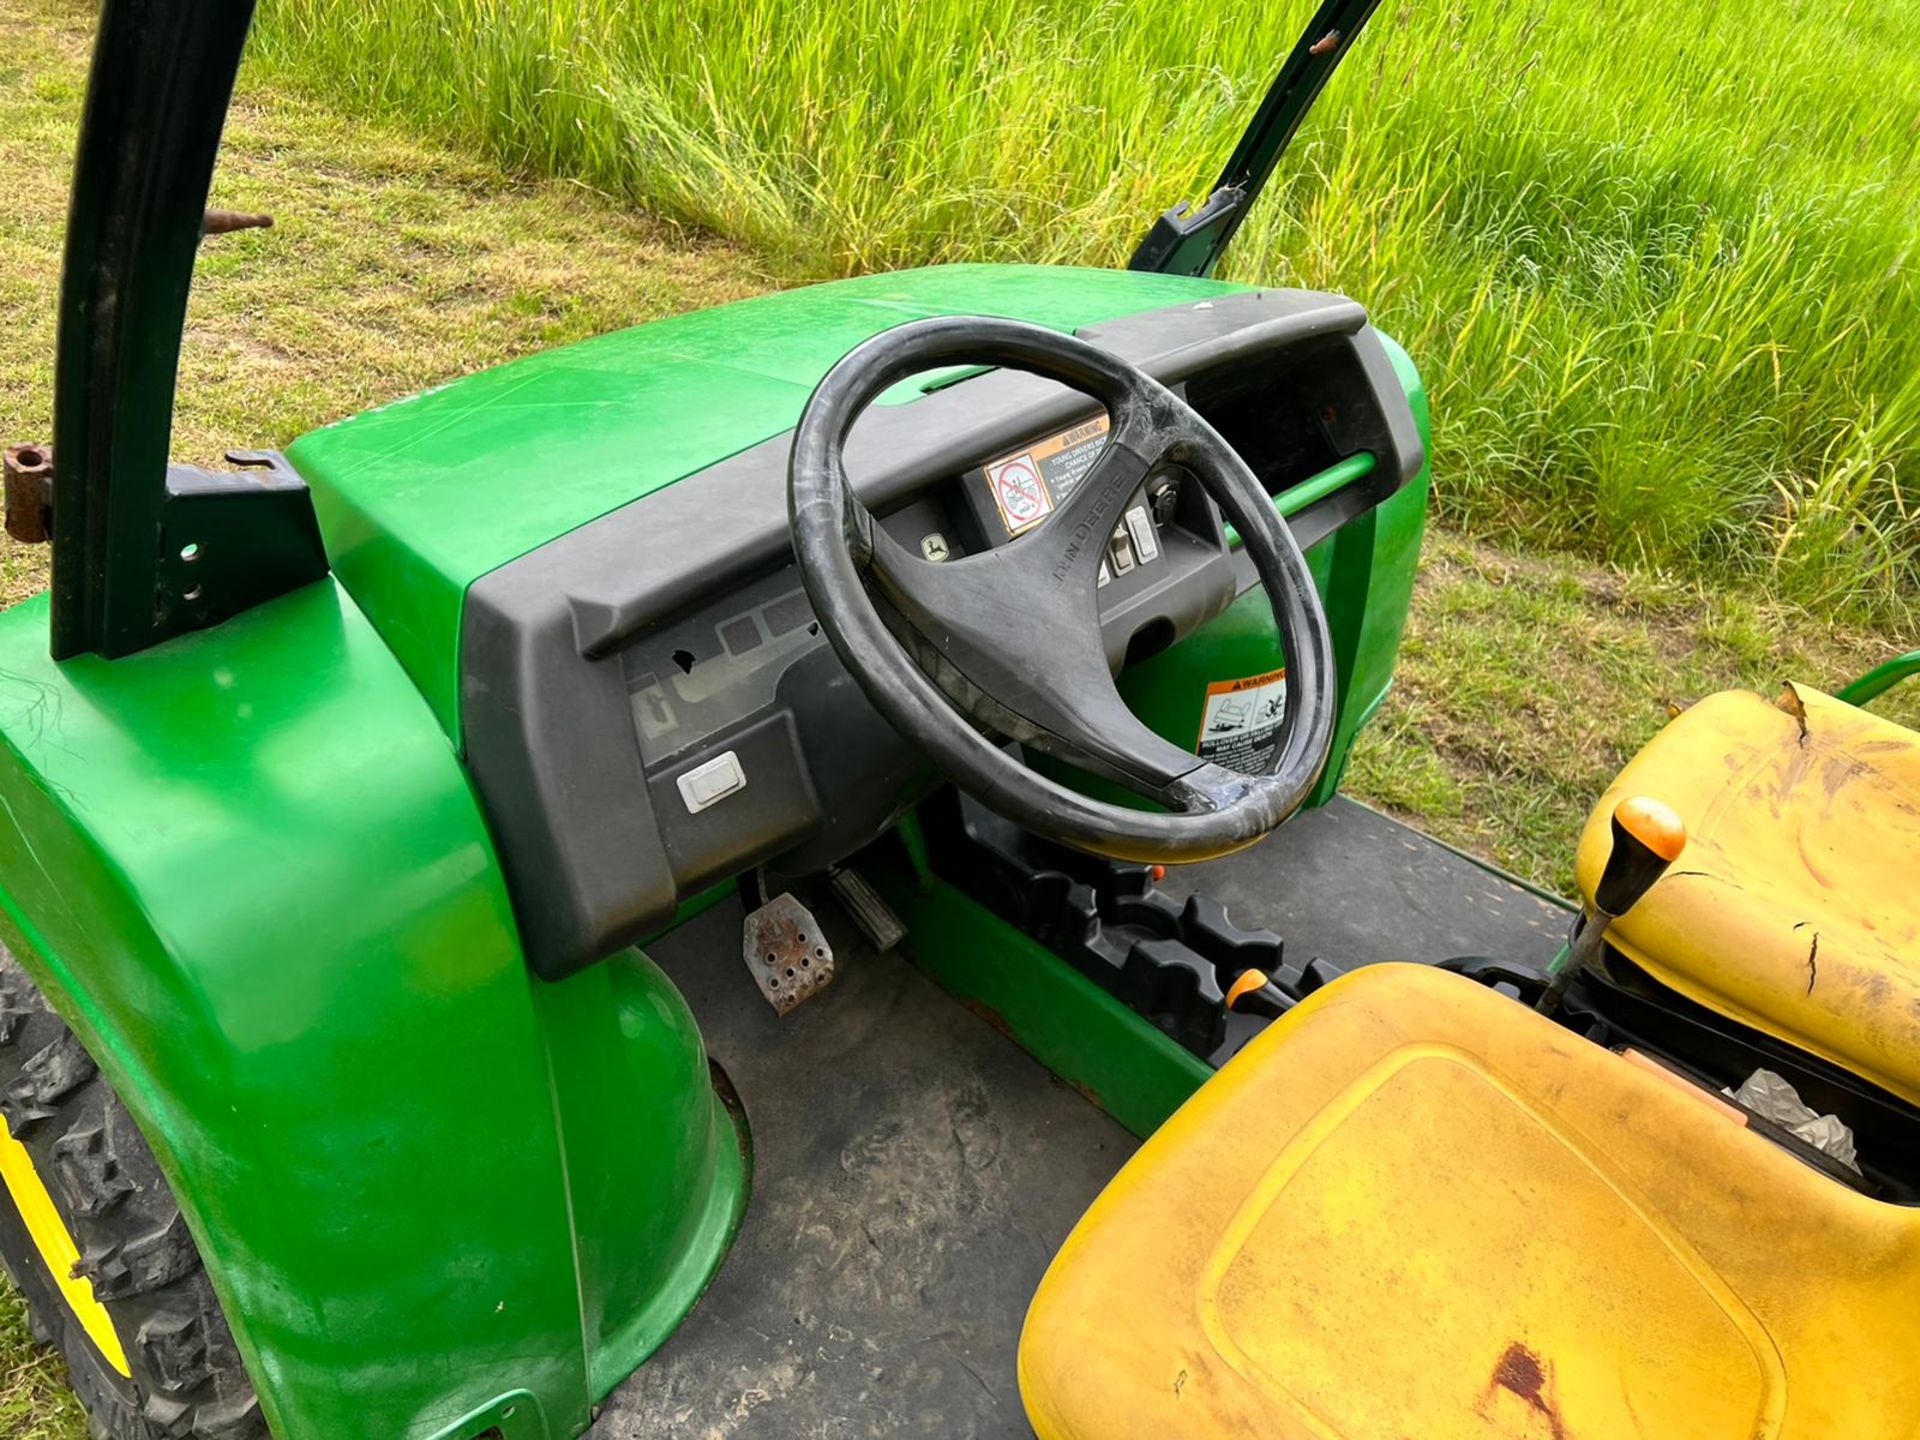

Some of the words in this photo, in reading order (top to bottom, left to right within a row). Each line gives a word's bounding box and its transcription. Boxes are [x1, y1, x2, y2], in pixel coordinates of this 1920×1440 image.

[1074, 474, 1126, 545] DEERE
[1216, 743, 1231, 753] MAY
[1231, 737, 1253, 750] CAUSE
[1253, 731, 1273, 743] DEATH
